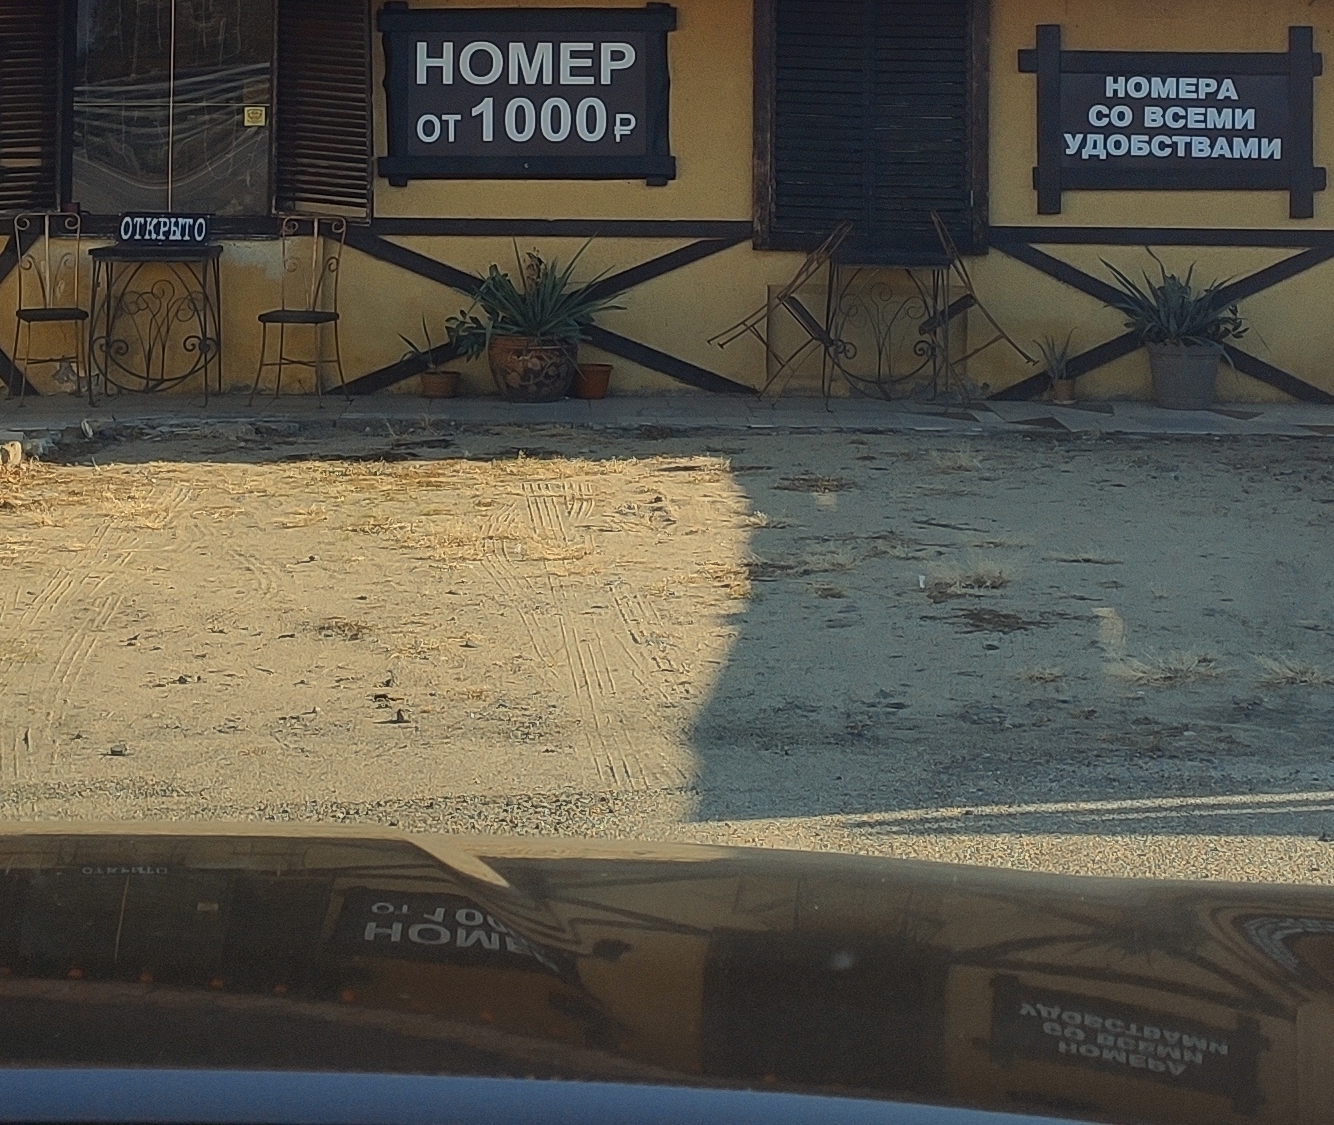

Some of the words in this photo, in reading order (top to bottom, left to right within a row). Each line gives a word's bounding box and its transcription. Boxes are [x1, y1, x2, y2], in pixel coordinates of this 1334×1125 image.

[416, 41, 636, 85] НОМЕР
[1104, 75, 1239, 101] НОМЕРА
[1087, 105, 1134, 129] СО
[1142, 105, 1257, 131] ВСЕМИ
[1063, 131, 1283, 161] УДОБСТВАМИ
[120, 216, 207, 242] ОТКРЫТО
